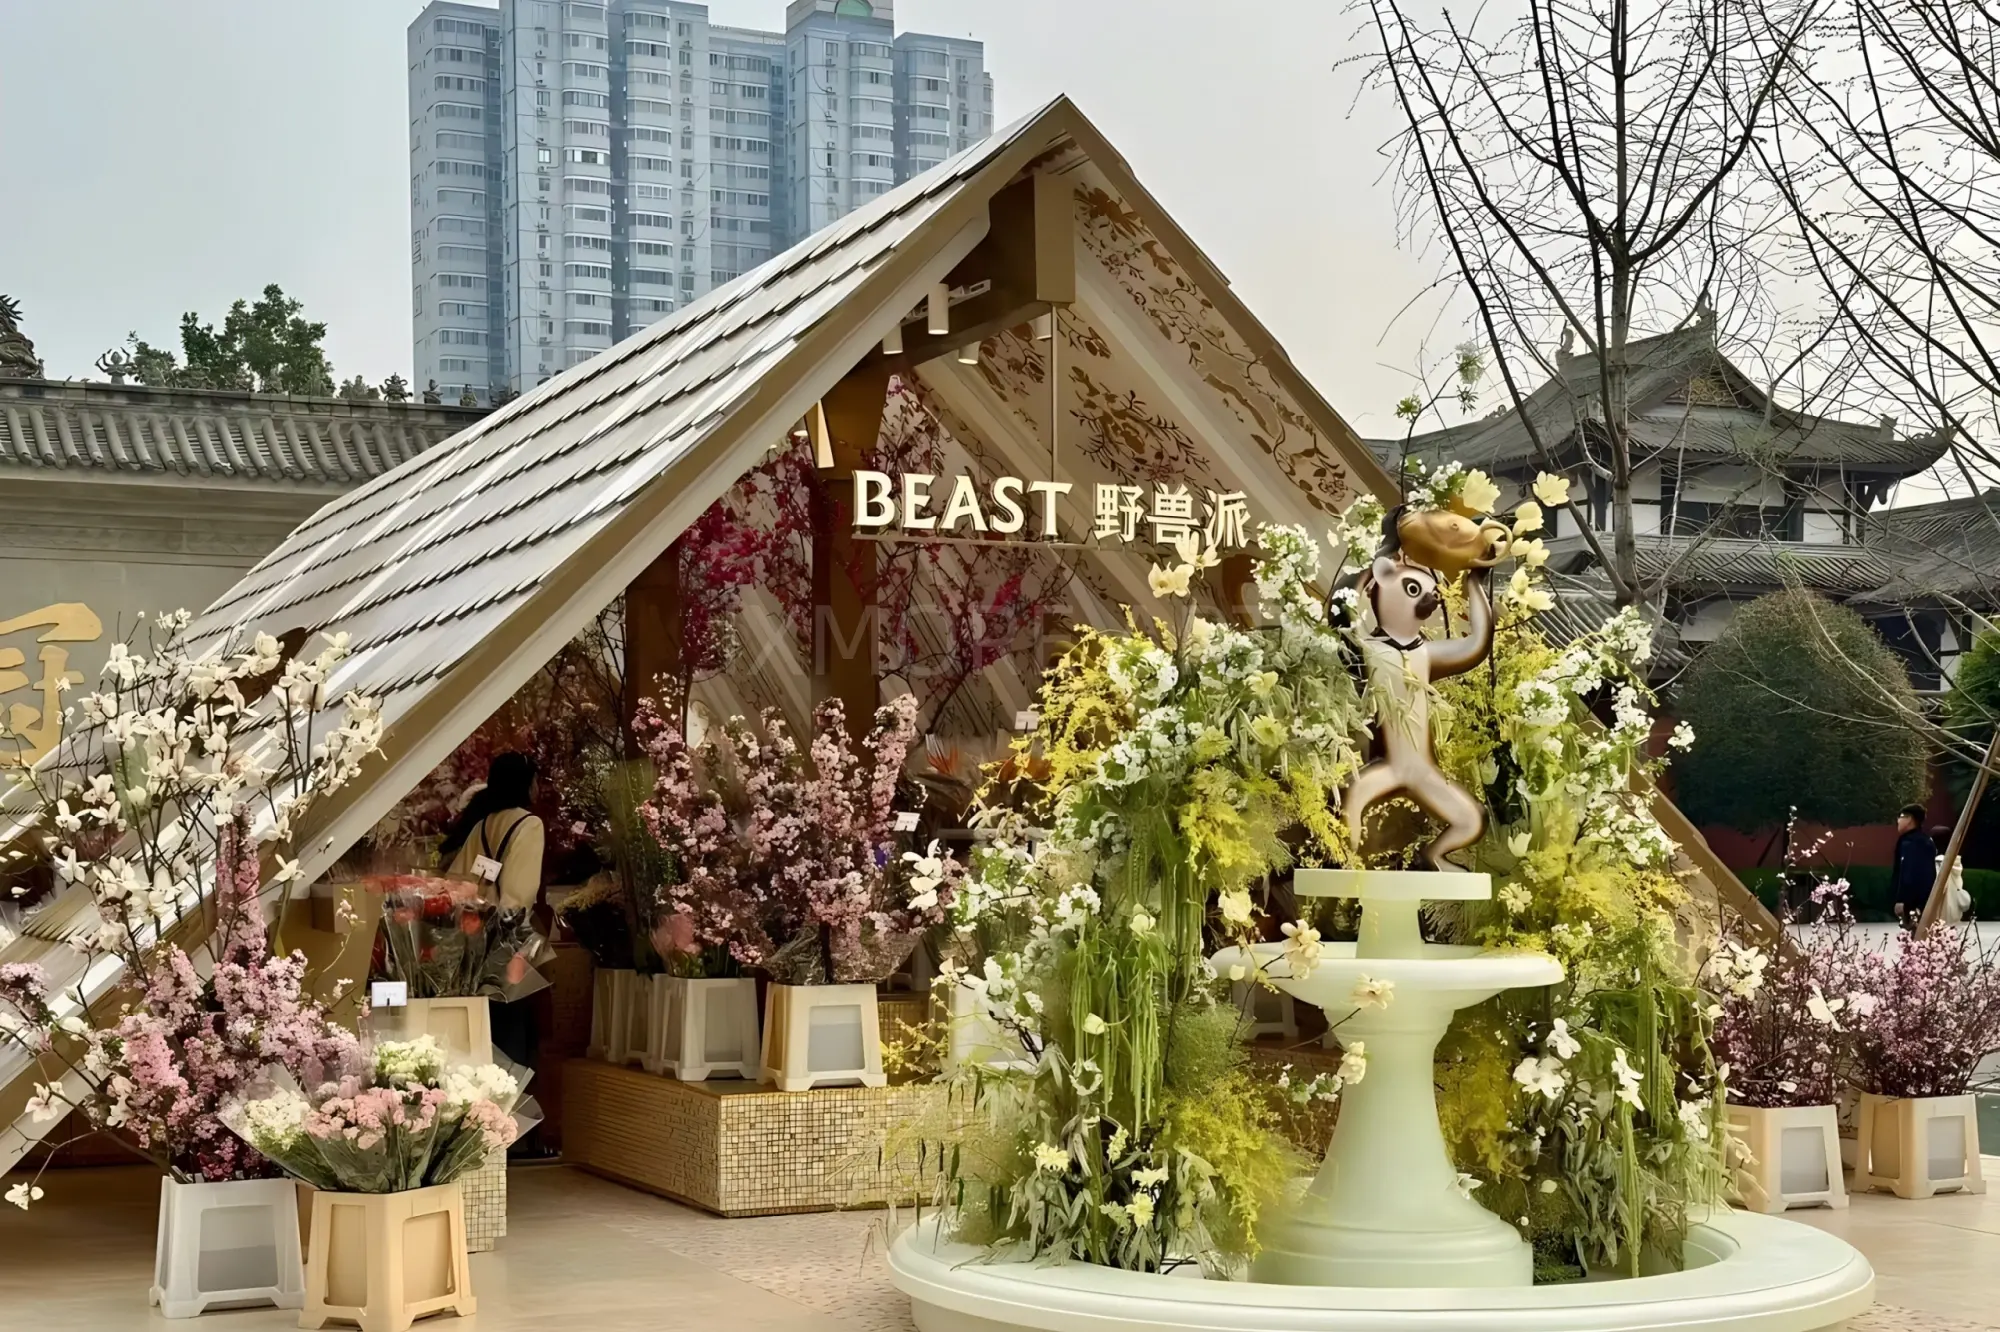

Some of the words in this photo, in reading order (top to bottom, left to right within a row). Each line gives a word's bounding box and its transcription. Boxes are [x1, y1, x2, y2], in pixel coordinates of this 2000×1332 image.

[852, 469, 1073, 536] BEAST
[1093, 482, 1251, 549] 野兽派
